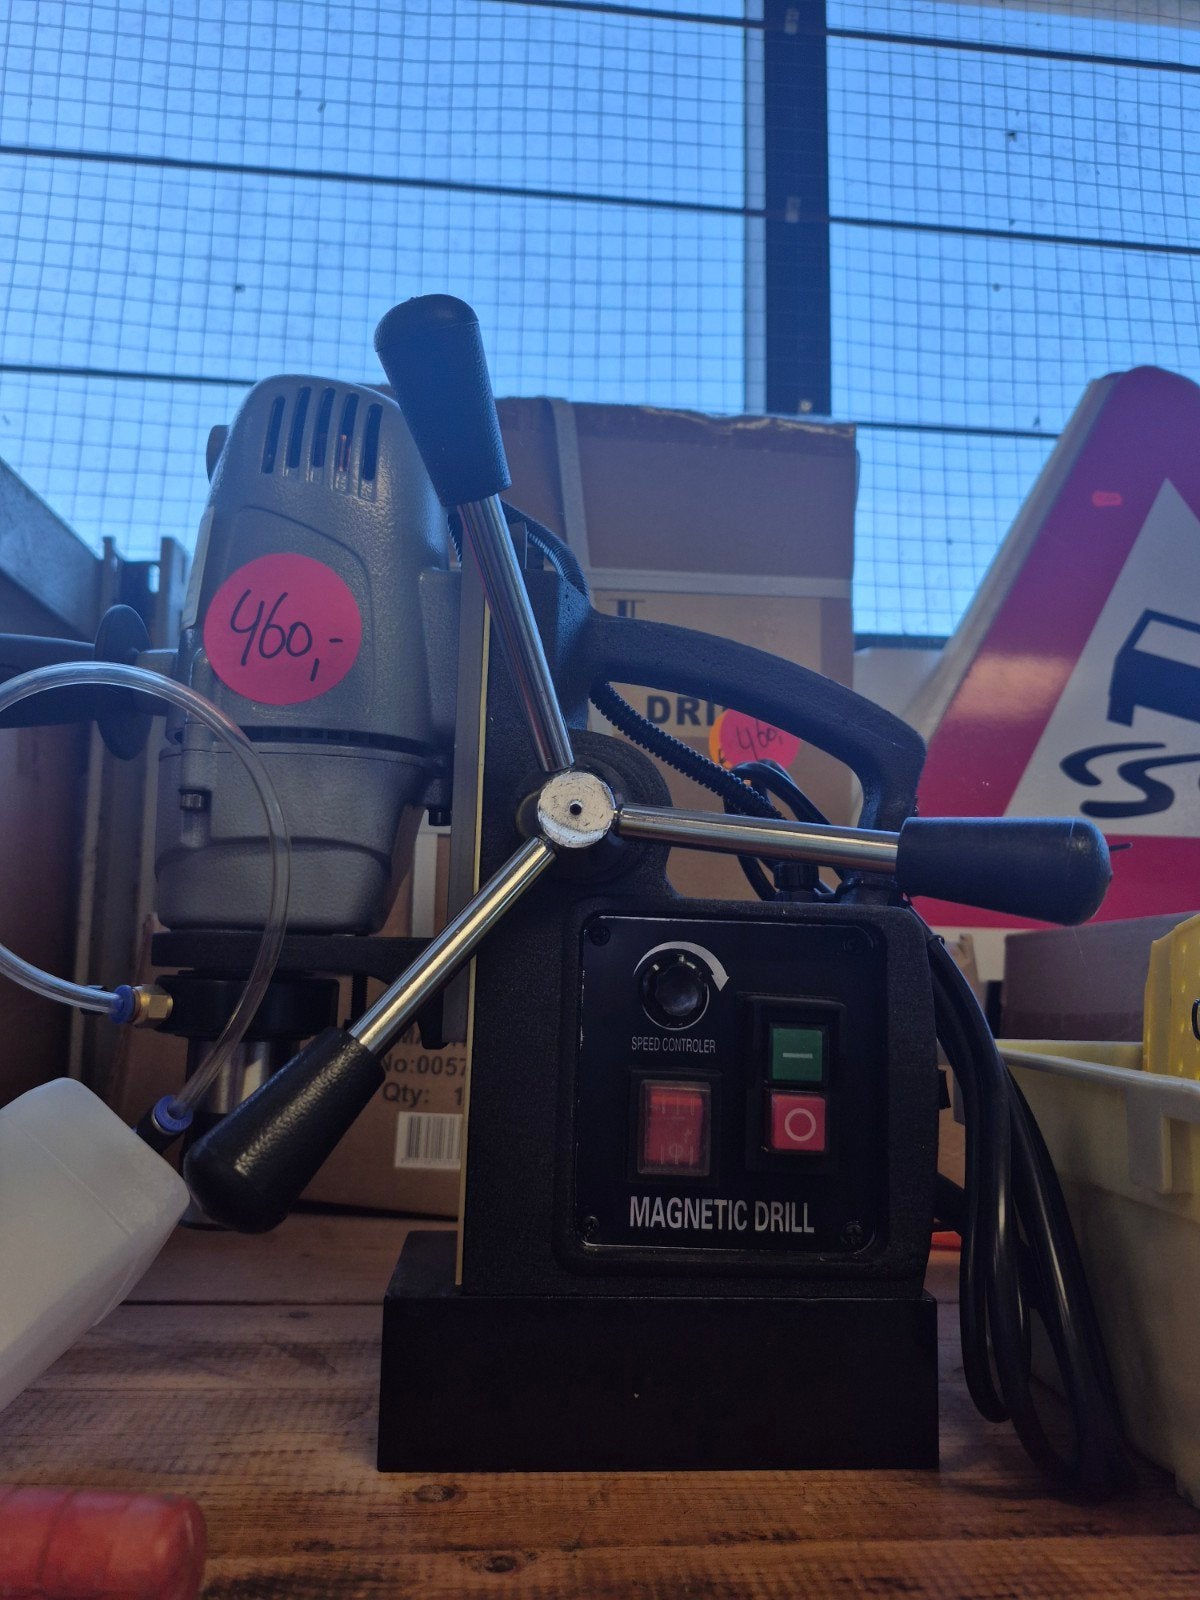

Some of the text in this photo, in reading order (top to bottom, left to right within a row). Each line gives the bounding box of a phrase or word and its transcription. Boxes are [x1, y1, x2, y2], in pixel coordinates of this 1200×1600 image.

[646, 695, 728, 726] DRI
[631, 1036, 716, 1053] SPEED CONTROLER
[383, 1082, 430, 1108] Qty:
[629, 1195, 815, 1233] MAGNETIC DRILL
